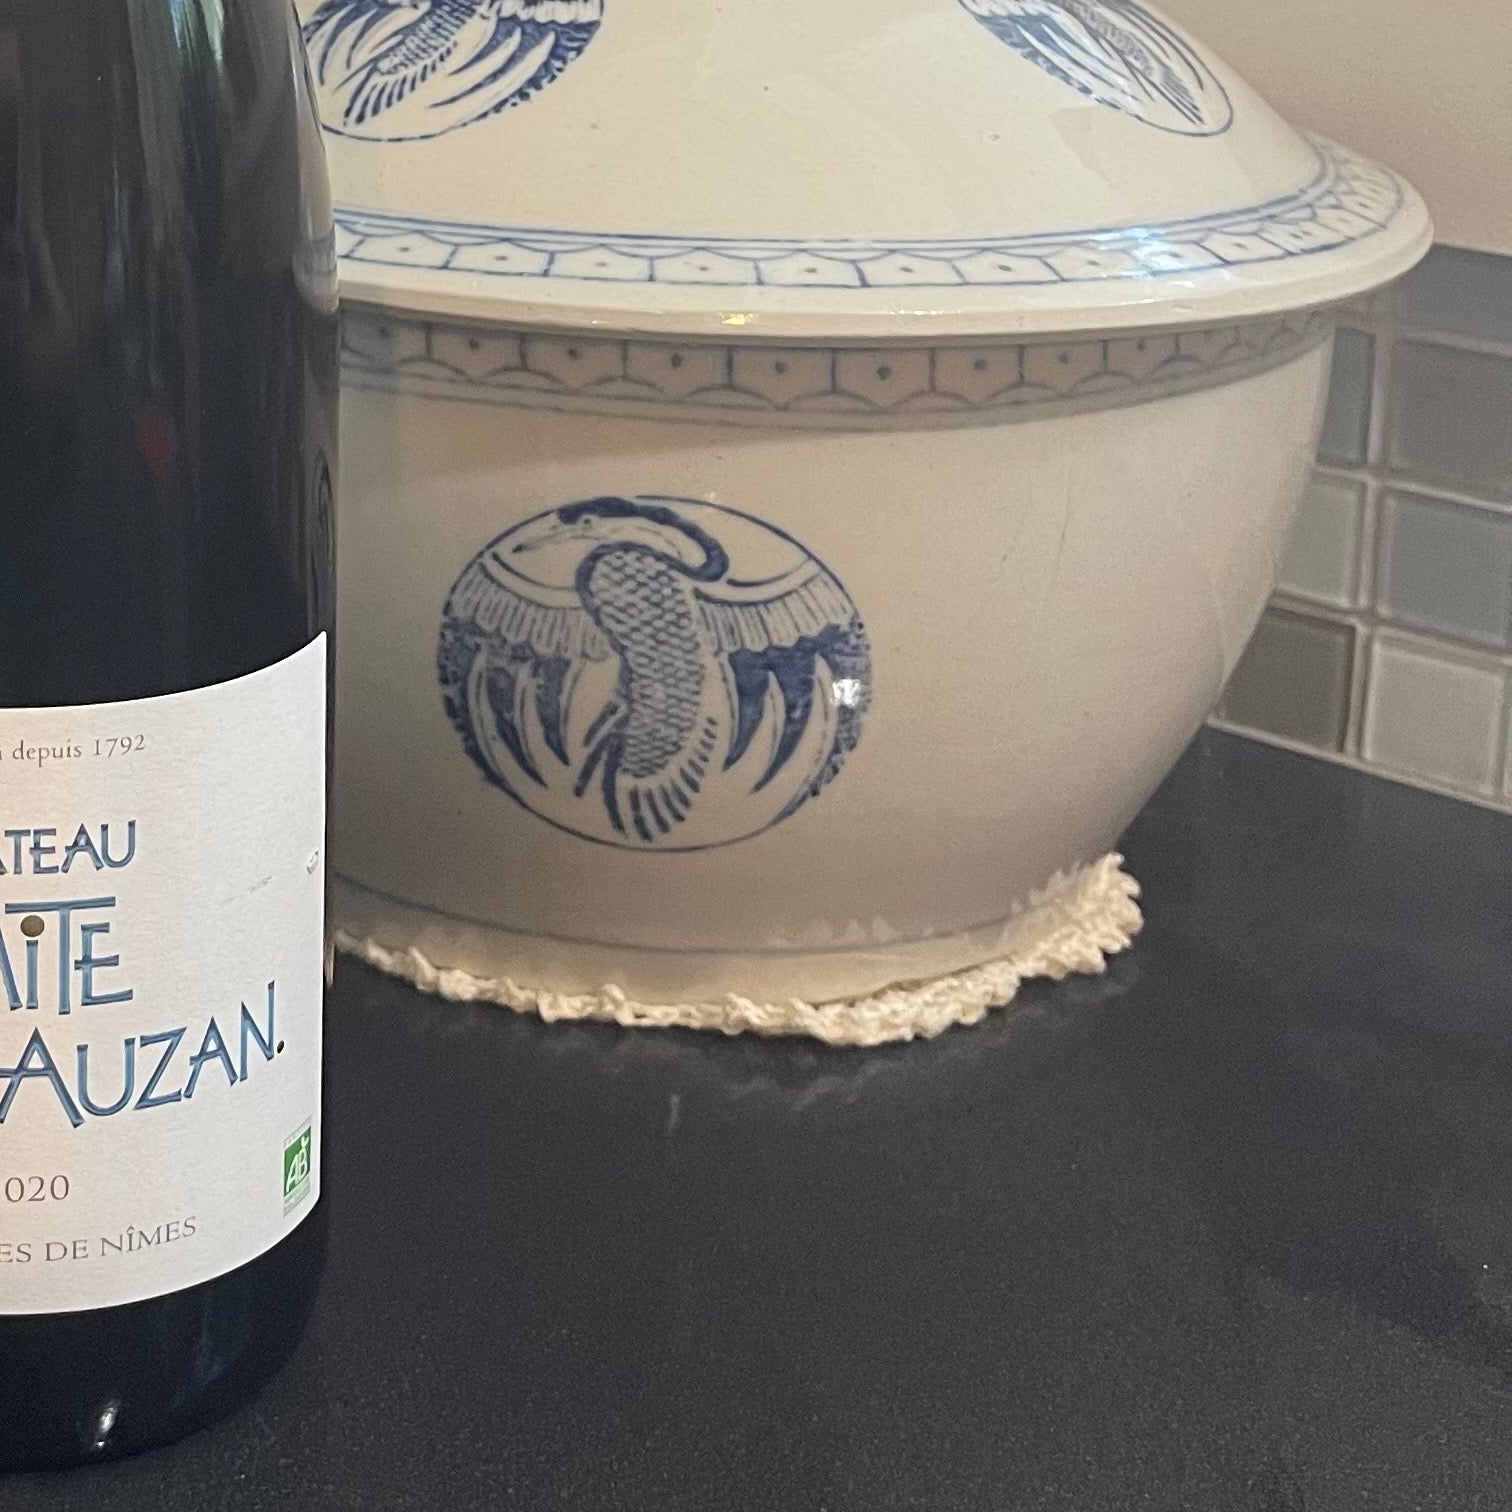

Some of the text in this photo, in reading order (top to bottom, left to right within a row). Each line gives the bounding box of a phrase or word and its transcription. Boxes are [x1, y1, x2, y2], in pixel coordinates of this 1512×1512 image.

[12, 738, 83, 768] depuis
[93, 734, 146, 758] 1792
[45, 1238, 89, 1263] DE
[100, 1215, 198, 1257] NÎMES
